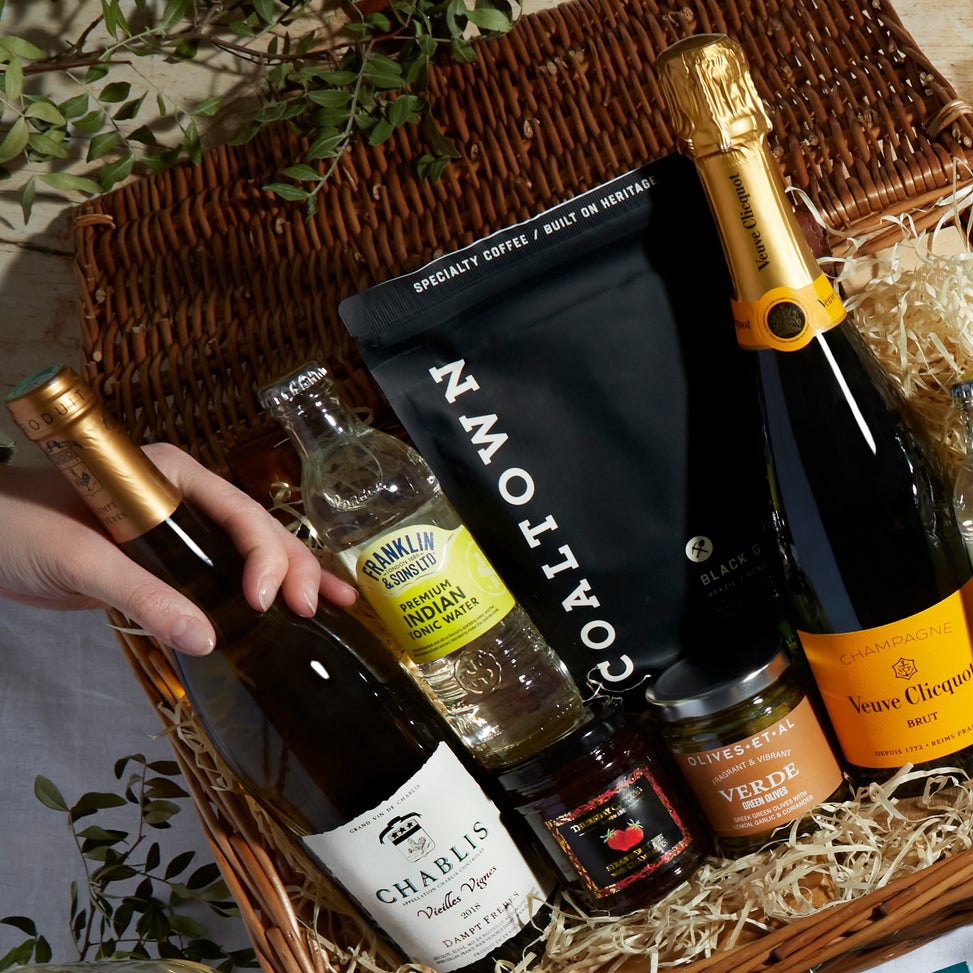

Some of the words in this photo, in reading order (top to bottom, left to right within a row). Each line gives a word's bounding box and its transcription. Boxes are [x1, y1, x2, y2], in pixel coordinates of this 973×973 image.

[729, 173, 757, 229] Clicquot
[412, 255, 480, 294] SPECIALTY
[482, 234, 530, 262] COFFEE
[542, 211, 578, 236] BUILT
[580, 202, 599, 219] ON
[600, 175, 657, 210] HERITAGE
[751, 232, 771, 272] Veuve
[429, 358, 635, 684] COALTOWN
[362, 531, 435, 581] FRANKLIN
[382, 578, 393, 590] &
[392, 564, 420, 587] SONS
[418, 552, 437, 572] LTD
[700, 553, 747, 585] BLACK
[400, 579, 452, 613] PREMIUM
[402, 585, 467, 628] INDIAN
[408, 621, 443, 641] TONIC
[443, 596, 480, 623] WATER
[840, 622, 953, 666] CHAMPAGNE
[847, 694, 901, 716] Veuve
[906, 711, 939, 729] BRUT
[874, 748, 903, 758] DEPUIS
[904, 745, 924, 754] 1772
[931, 733, 956, 748] REIMS
[712, 762, 747, 785] FRAGRANT
[757, 749, 792, 763] VIBRANT
[718, 762, 799, 802] VERDE
[349, 819, 372, 834] GRAND
[372, 811, 385, 822] VIN
[386, 805, 395, 813] DE
[396, 783, 421, 805] CHABLIS
[742, 797, 765, 811] GREEN
[765, 786, 789, 802] OLIVES
[375, 820, 491, 905] CHABLIS
[416, 891, 463, 920] Vieilles
[460, 865, 498, 893] Vignes
[460, 902, 482, 920] 2018
[442, 922, 482, 949] DAMPT
